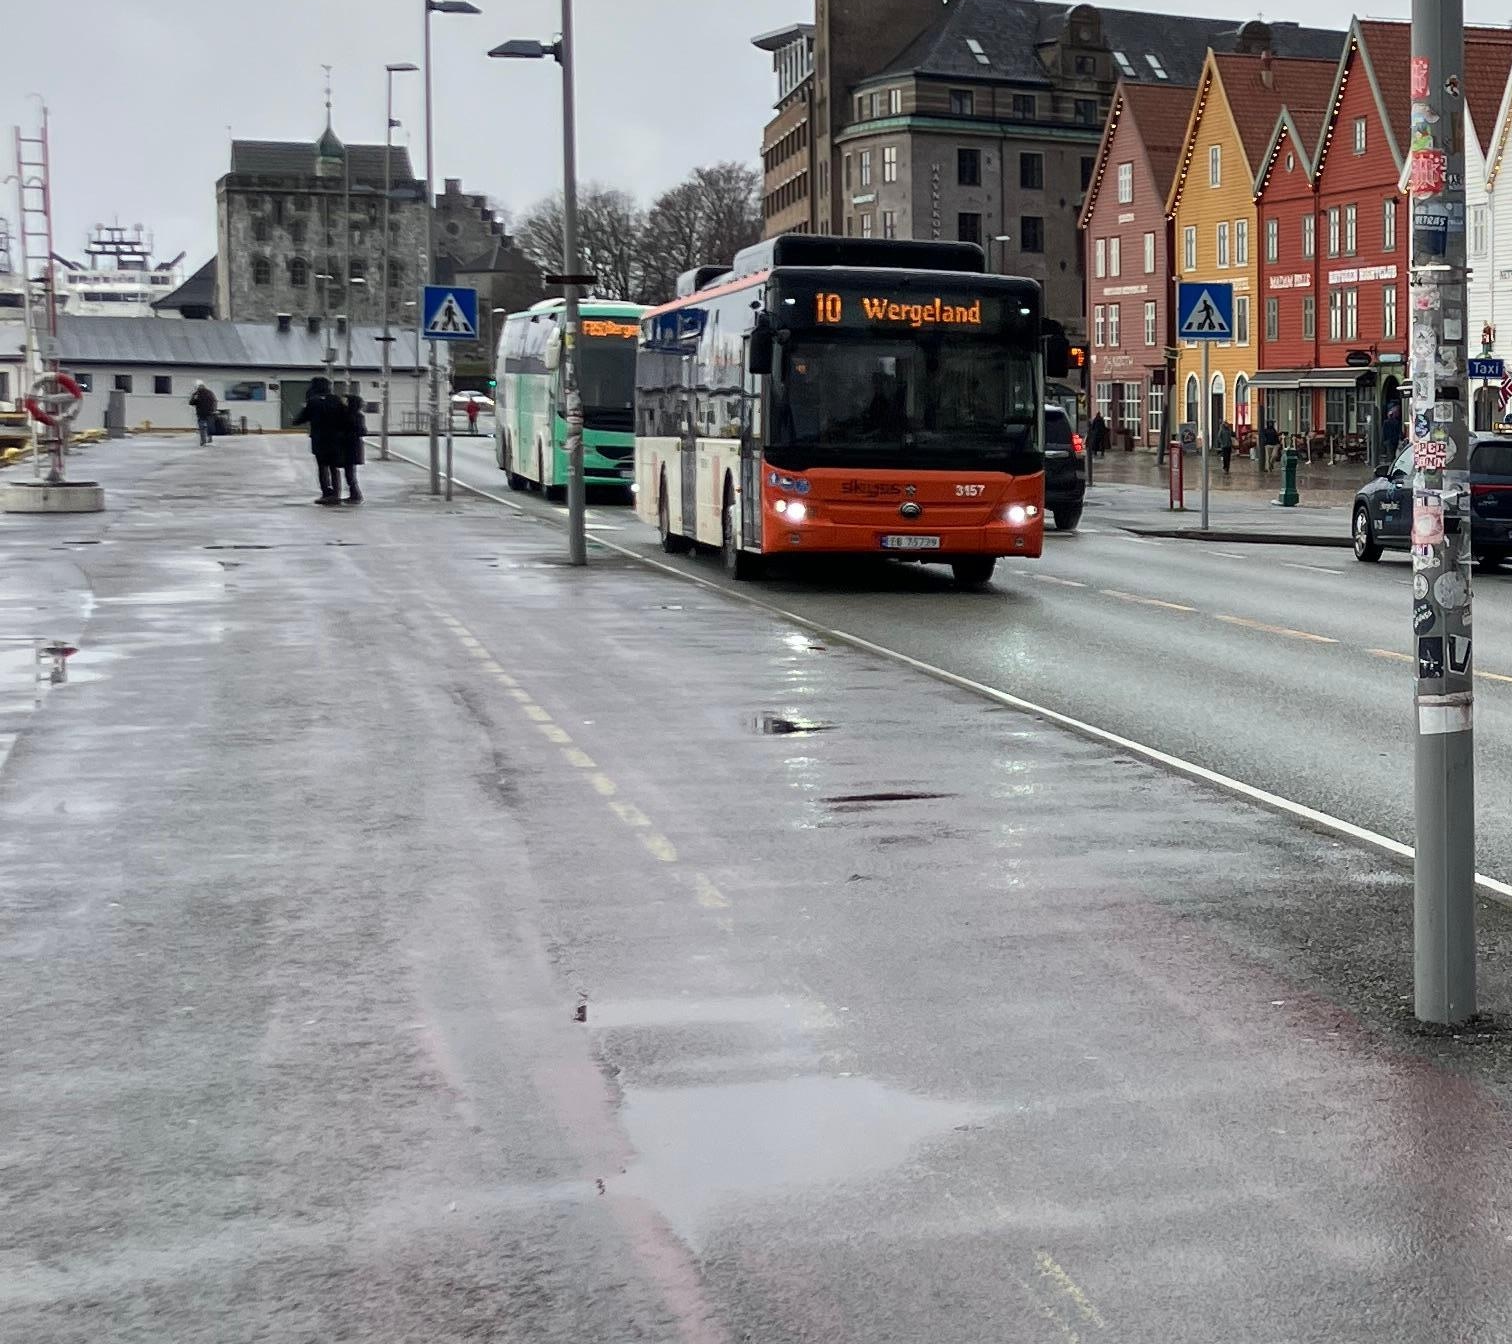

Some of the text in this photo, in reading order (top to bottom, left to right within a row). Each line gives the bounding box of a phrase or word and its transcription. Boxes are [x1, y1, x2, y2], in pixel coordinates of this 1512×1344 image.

[816, 292, 981, 327] 10 Wergeland
[1473, 361, 1499, 375] Taxi
